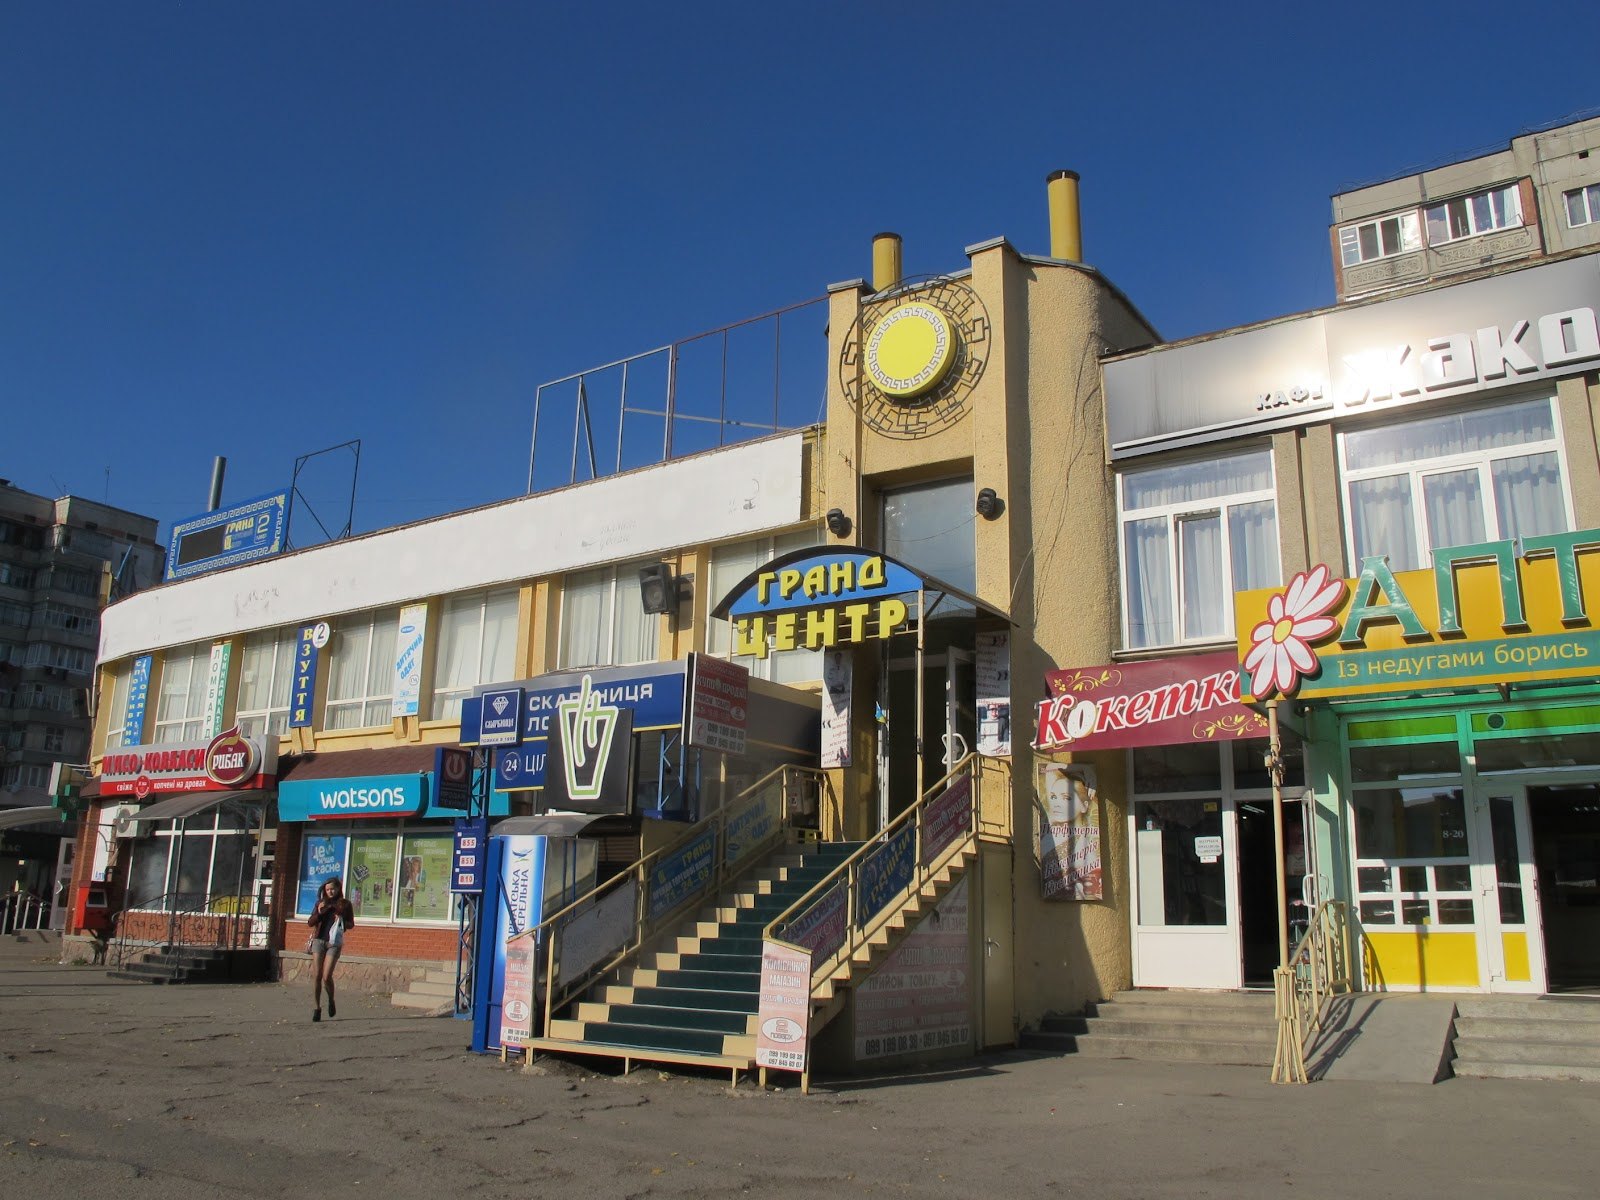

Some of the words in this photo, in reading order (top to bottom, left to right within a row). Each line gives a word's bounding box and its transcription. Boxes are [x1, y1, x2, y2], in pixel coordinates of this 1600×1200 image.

[225, 516, 255, 535] ГРАНД
[758, 556, 884, 604] ГРАНД
[317, 624, 327, 640] 2
[738, 600, 907, 658] ЦЕНТР
[1337, 659, 1359, 678] Із
[1367, 650, 1485, 676] недугами
[1494, 641, 1589, 666] борись
[294, 628, 314, 722] ВЗУТТЯ
[204, 649, 221, 740] ЛОМБАРД
[213, 753, 245, 770] РИБАК
[506, 759, 517, 773] 24
[116, 784, 133, 792] свіже
[320, 787, 405, 809] watsons
[1443, 830, 1464, 838] 8-20
[769, 975, 801, 988] МАГАЗИН
